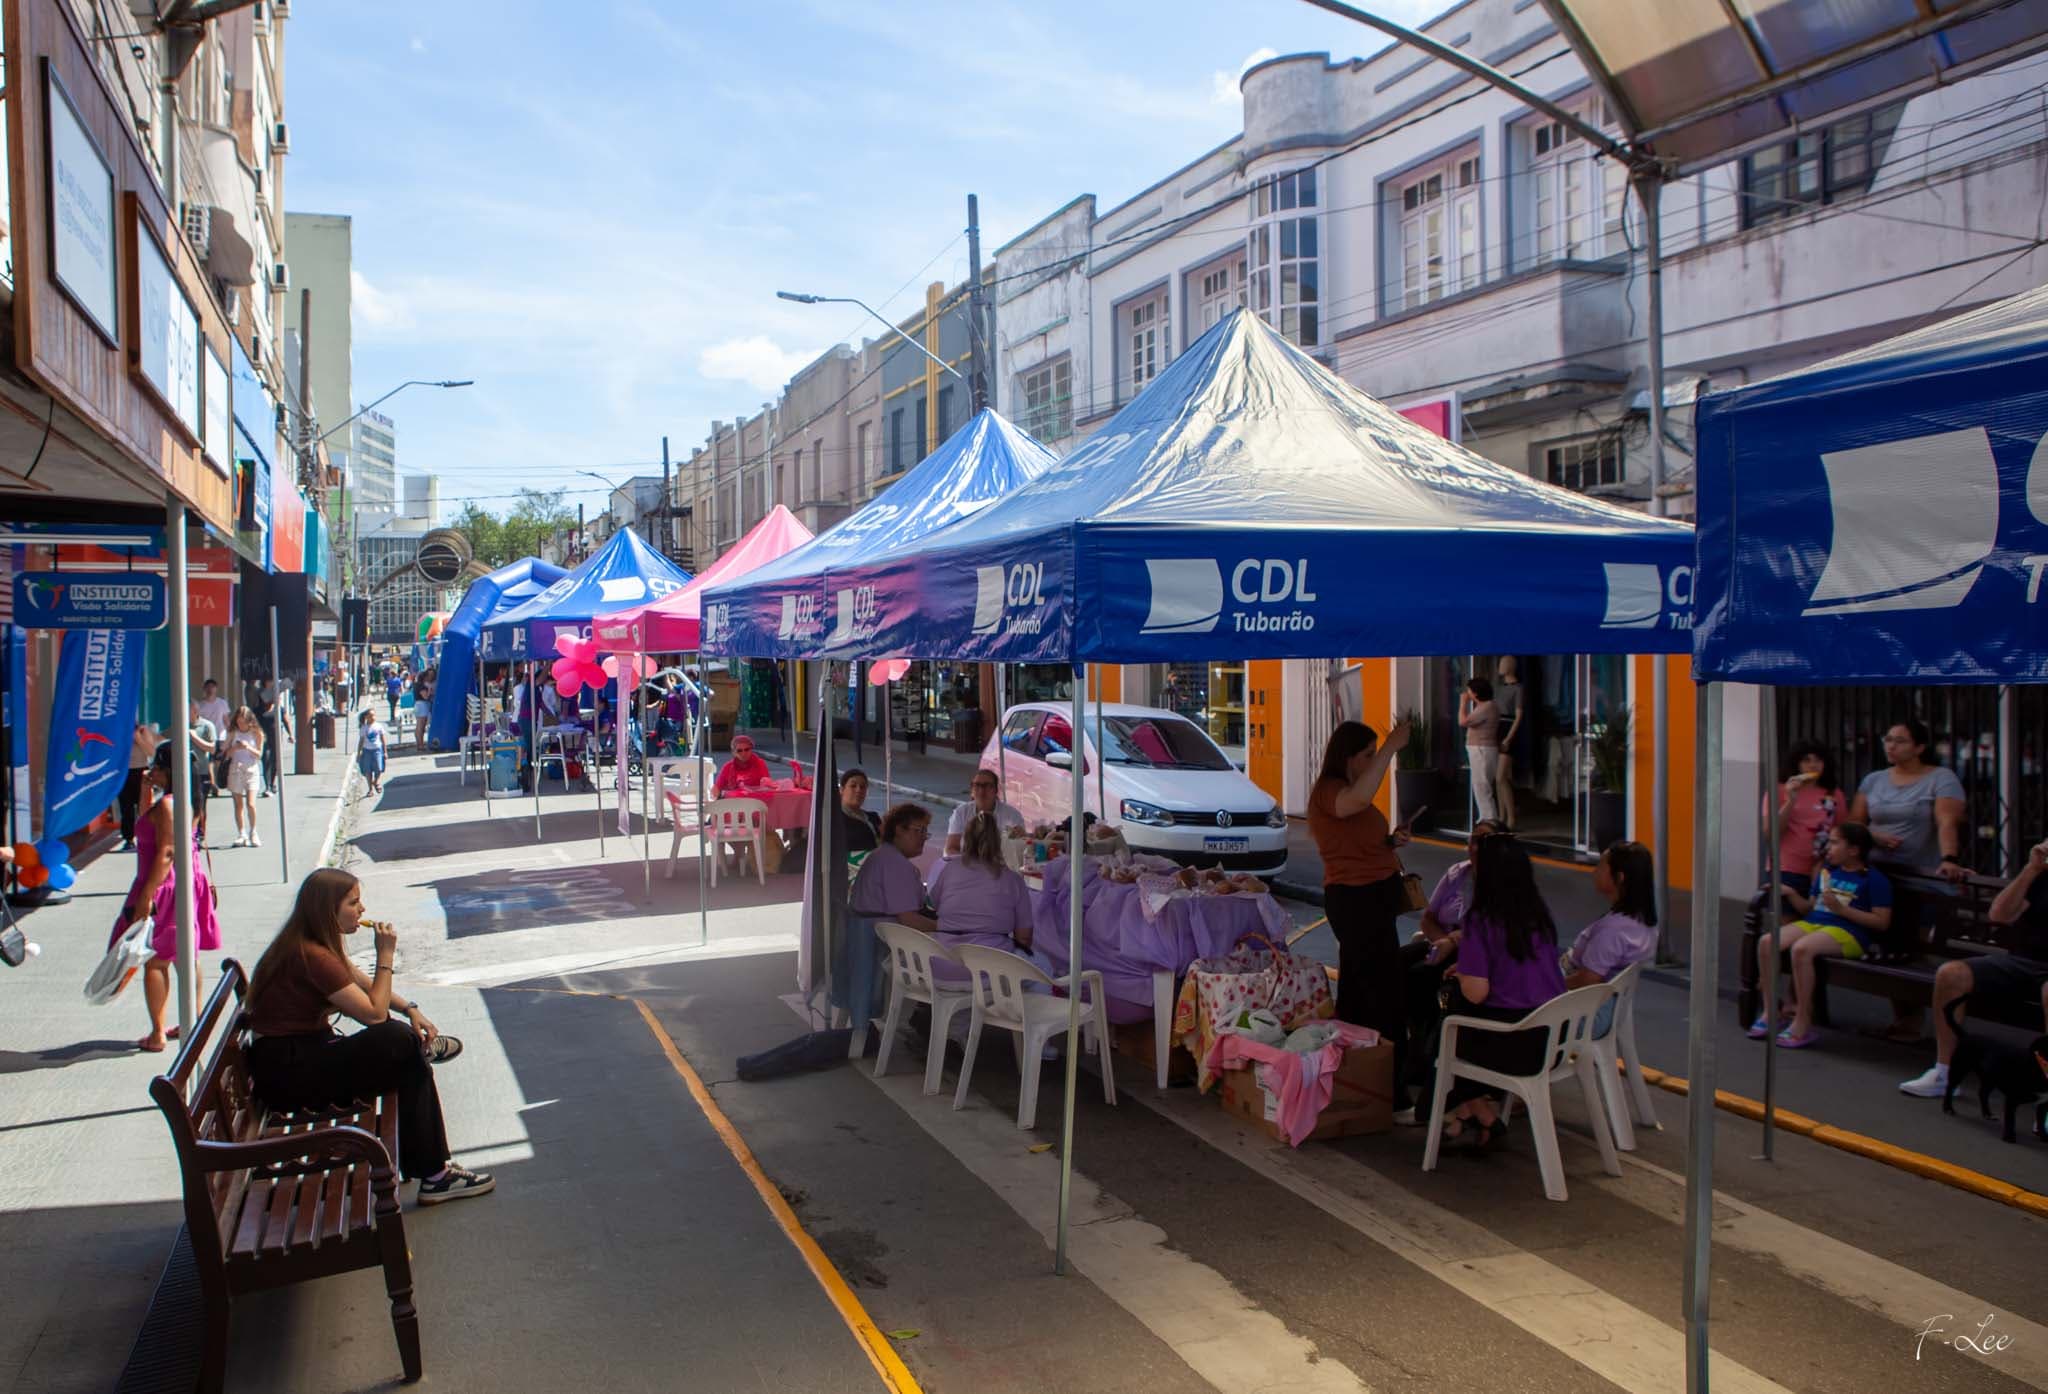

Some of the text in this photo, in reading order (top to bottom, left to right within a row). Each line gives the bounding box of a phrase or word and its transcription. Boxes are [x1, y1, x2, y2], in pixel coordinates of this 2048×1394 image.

[70, 586, 152, 599] INSTITUTO
[1007, 561, 1046, 608] CDL
[1231, 558, 1317, 604] CDL
[72, 601, 101, 612] Visão
[796, 594, 815, 624] CDL
[855, 584, 877, 620] CDL
[1004, 614, 1042, 635] Tubarão
[1232, 611, 1315, 633] Tubarão
[103, 680, 120, 718] Visão
